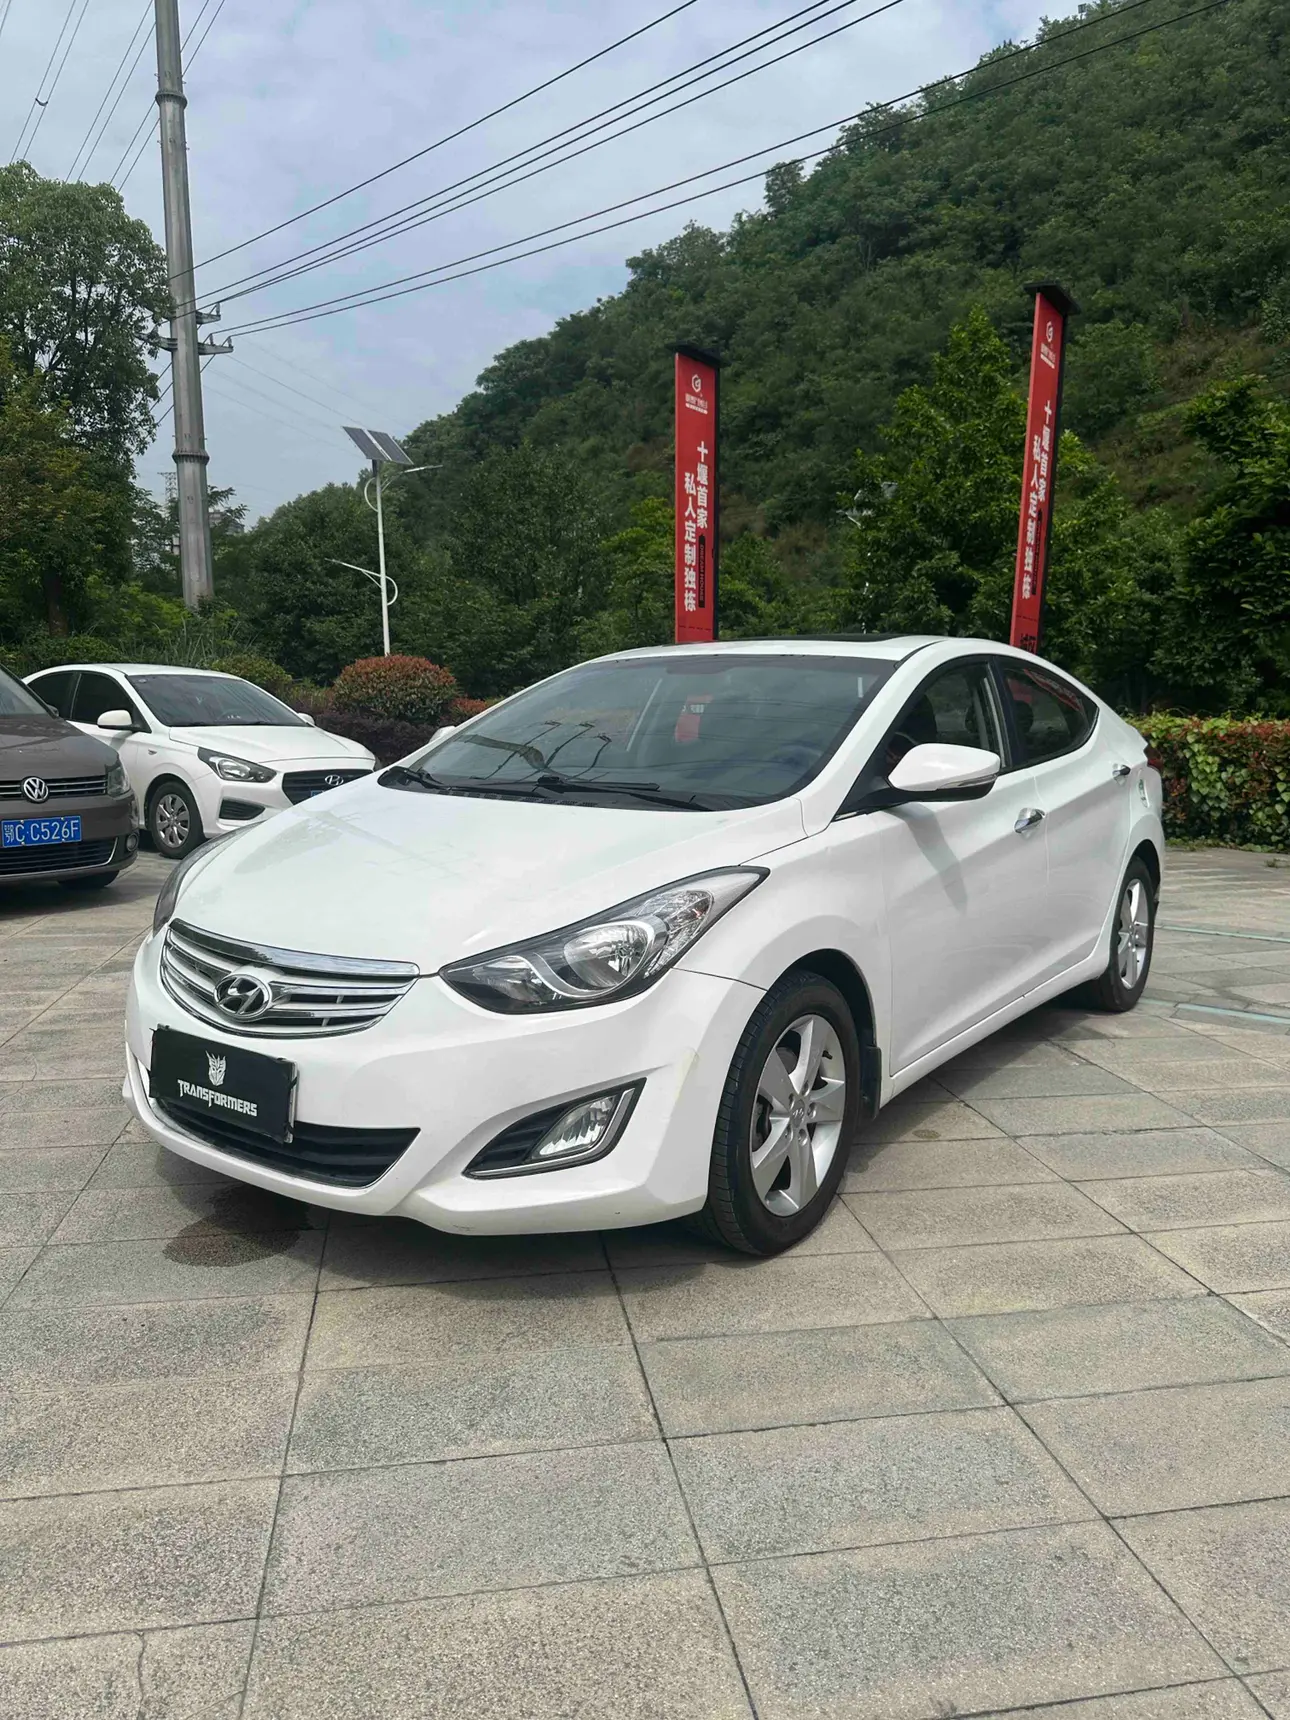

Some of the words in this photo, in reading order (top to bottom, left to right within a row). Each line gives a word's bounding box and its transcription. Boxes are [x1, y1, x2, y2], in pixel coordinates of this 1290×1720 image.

[697, 440, 708, 529] 十堰首家
[178, 1079, 258, 1117] TRANSFORMERS
